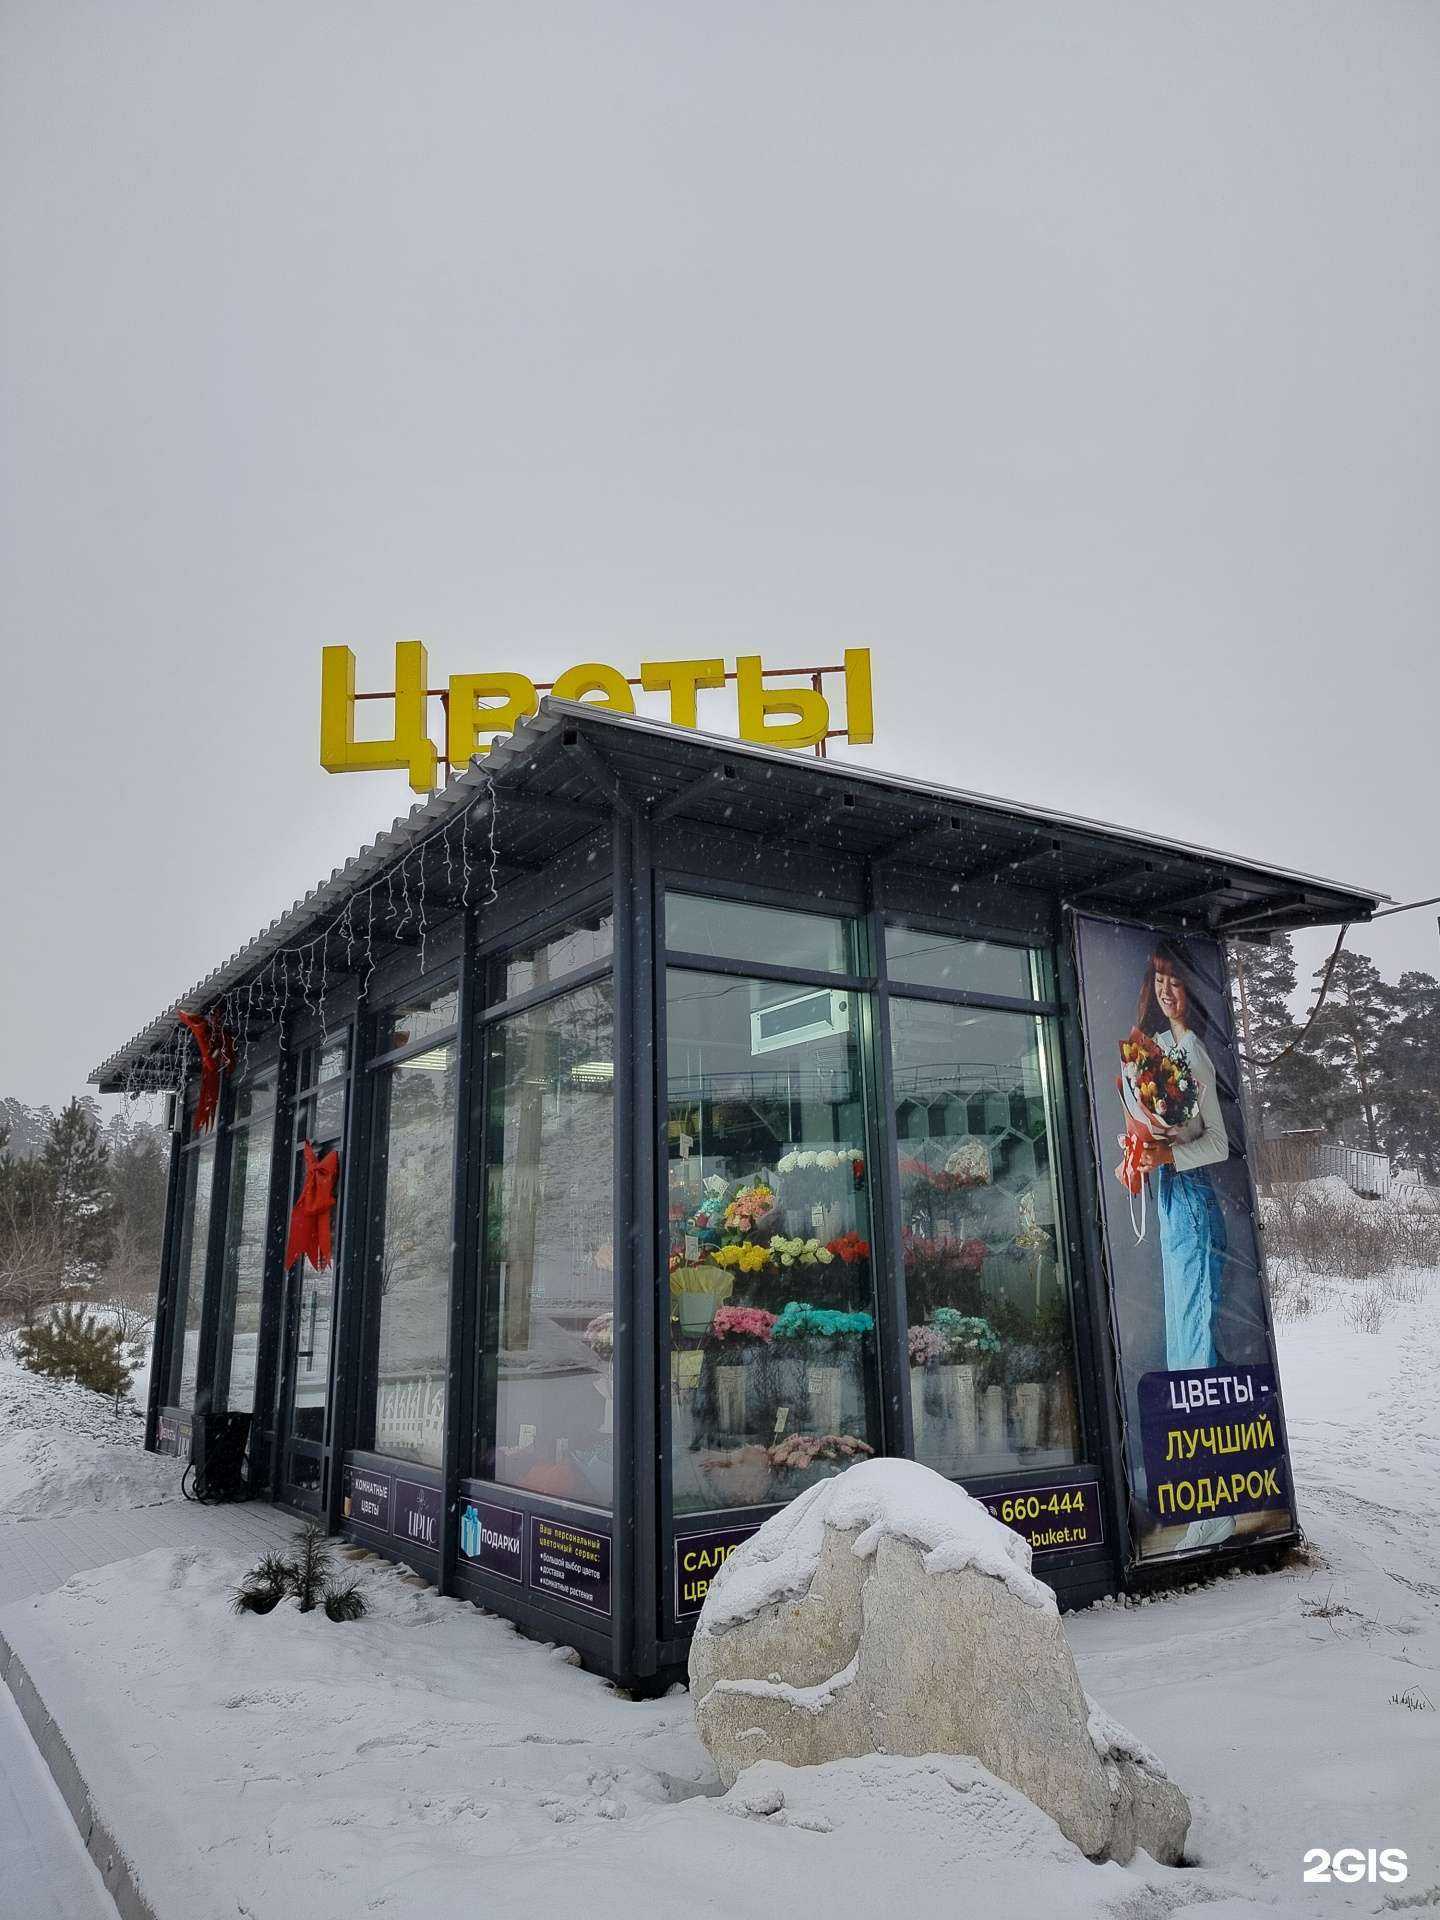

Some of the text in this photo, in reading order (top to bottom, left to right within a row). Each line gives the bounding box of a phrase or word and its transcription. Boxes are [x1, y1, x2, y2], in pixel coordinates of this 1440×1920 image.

[1168, 1374, 1255, 1413] ЦВЕТЫ
[1165, 1413, 1275, 1461] ЛУЧШИЙ
[354, 1478, 388, 1499] КОМНАТНЫЕ
[1157, 1467, 1282, 1514] ПОДАРОК
[360, 1499, 380, 1516] ЦВЕТЫ
[1001, 1491, 1085, 1522] 660-444
[481, 1528, 520, 1554] ПОДАРКИ
[539, 1538, 572, 1553] цветочный
[554, 1529, 600, 1549] персональный
[683, 1579, 713, 1602] ЦВ
